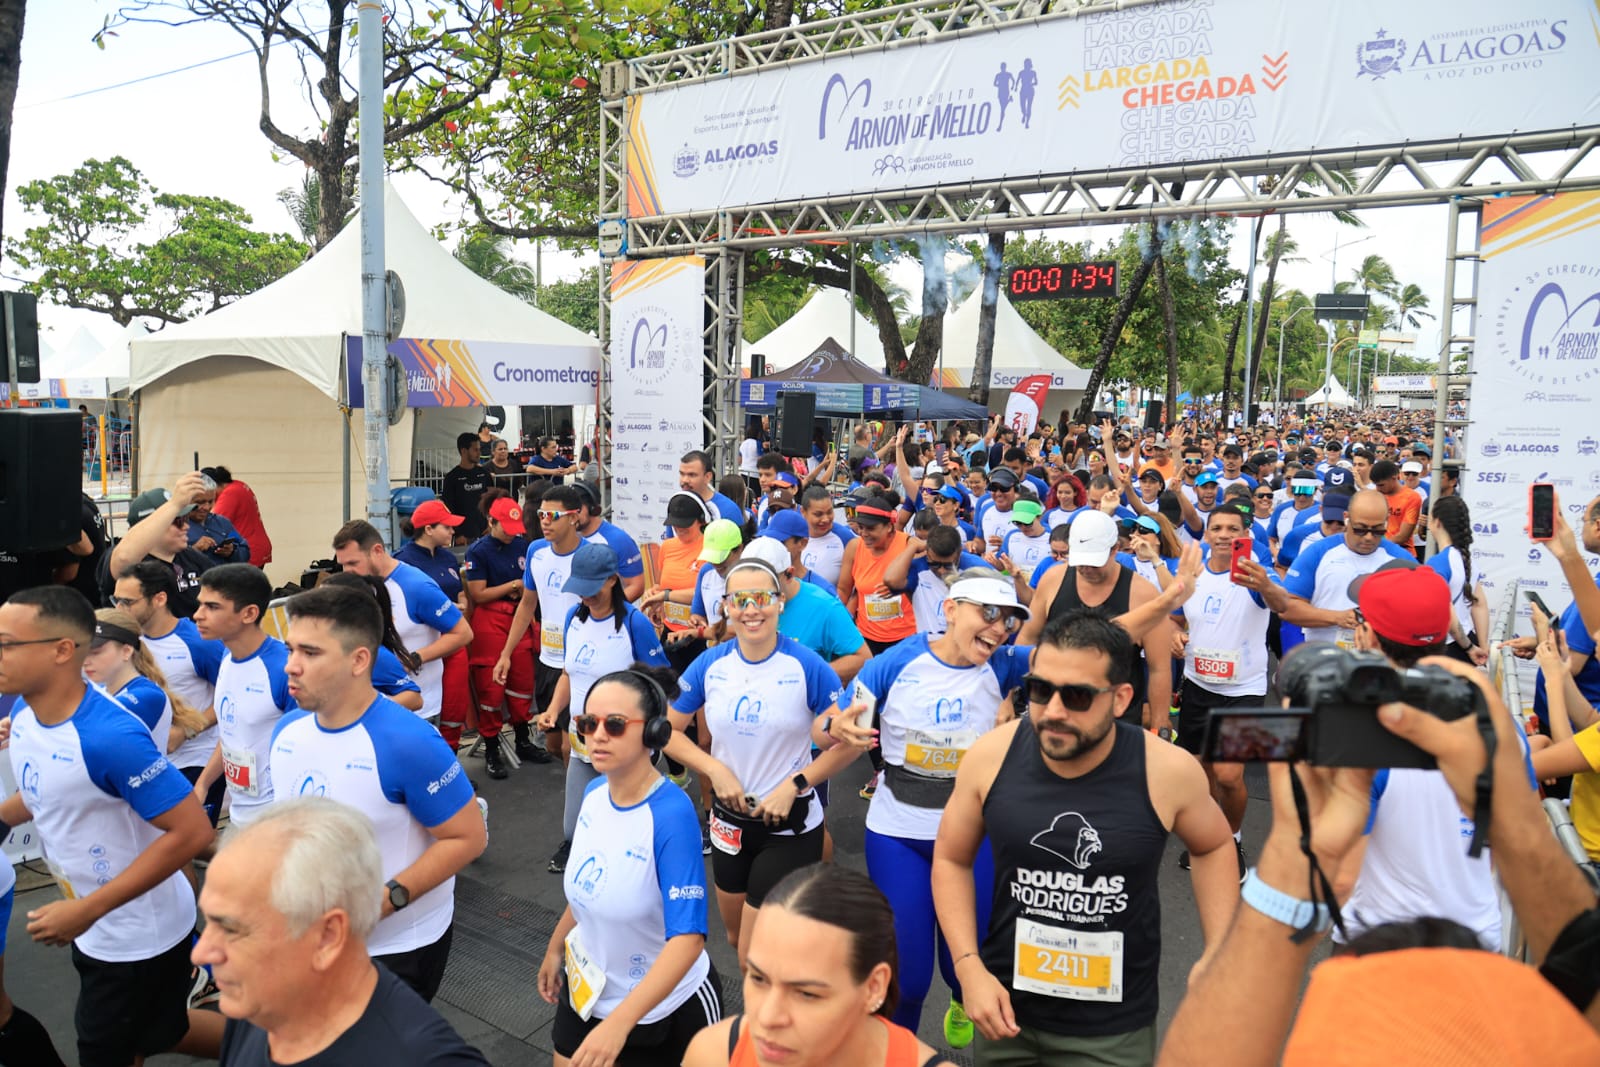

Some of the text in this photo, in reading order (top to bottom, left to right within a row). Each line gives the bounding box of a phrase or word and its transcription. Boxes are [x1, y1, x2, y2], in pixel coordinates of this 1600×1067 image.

[1084, 8, 1213, 49] LARGADA
[1409, 20, 1568, 67] ALAGOAS
[1083, 33, 1213, 72] LARGADA
[1083, 55, 1211, 92] LARGADA
[1423, 59, 1543, 81] A VOZ DO POVO
[1122, 73, 1257, 109] CHEGADA
[845, 101, 992, 151] ARNON DE MELLO
[1120, 95, 1256, 131] CHEGADA
[704, 140, 778, 164] ALAGOAS
[1120, 120, 1256, 155] CHEGADA
[1557, 331, 1600, 349] ARNON
[993, 372, 1064, 386] Secria
[1505, 444, 1559, 453] ALAGOAS
[1198, 659, 1229, 674] 3508
[921, 748, 958, 766] 764
[1017, 867, 1126, 895] DOUGLAS
[1010, 881, 1129, 916] RODRIGUES
[1036, 950, 1090, 980] 2411
